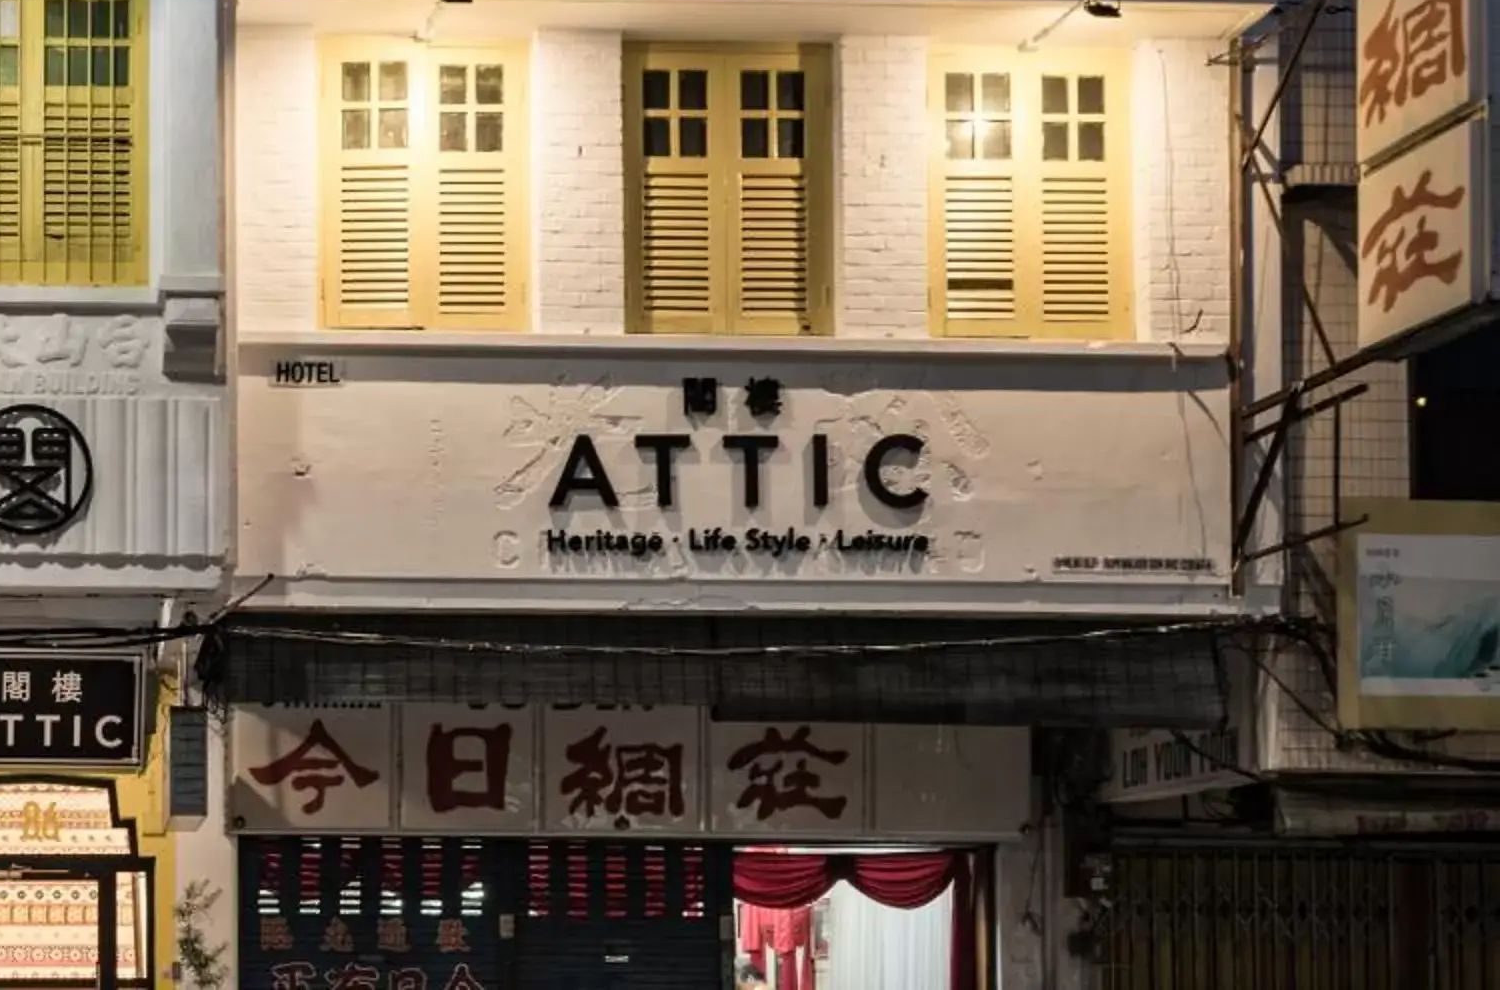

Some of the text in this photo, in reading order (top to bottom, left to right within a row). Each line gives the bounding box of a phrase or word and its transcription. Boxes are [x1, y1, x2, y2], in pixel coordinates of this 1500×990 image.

[276, 360, 341, 384] HOTEL
[548, 433, 929, 510] ATTIC
[547, 528, 664, 556] Heritage
[689, 526, 737, 552] Life
[744, 527, 811, 558] Style
[837, 529, 930, 554] Leisure
[1, 670, 84, 704] 閣樓
